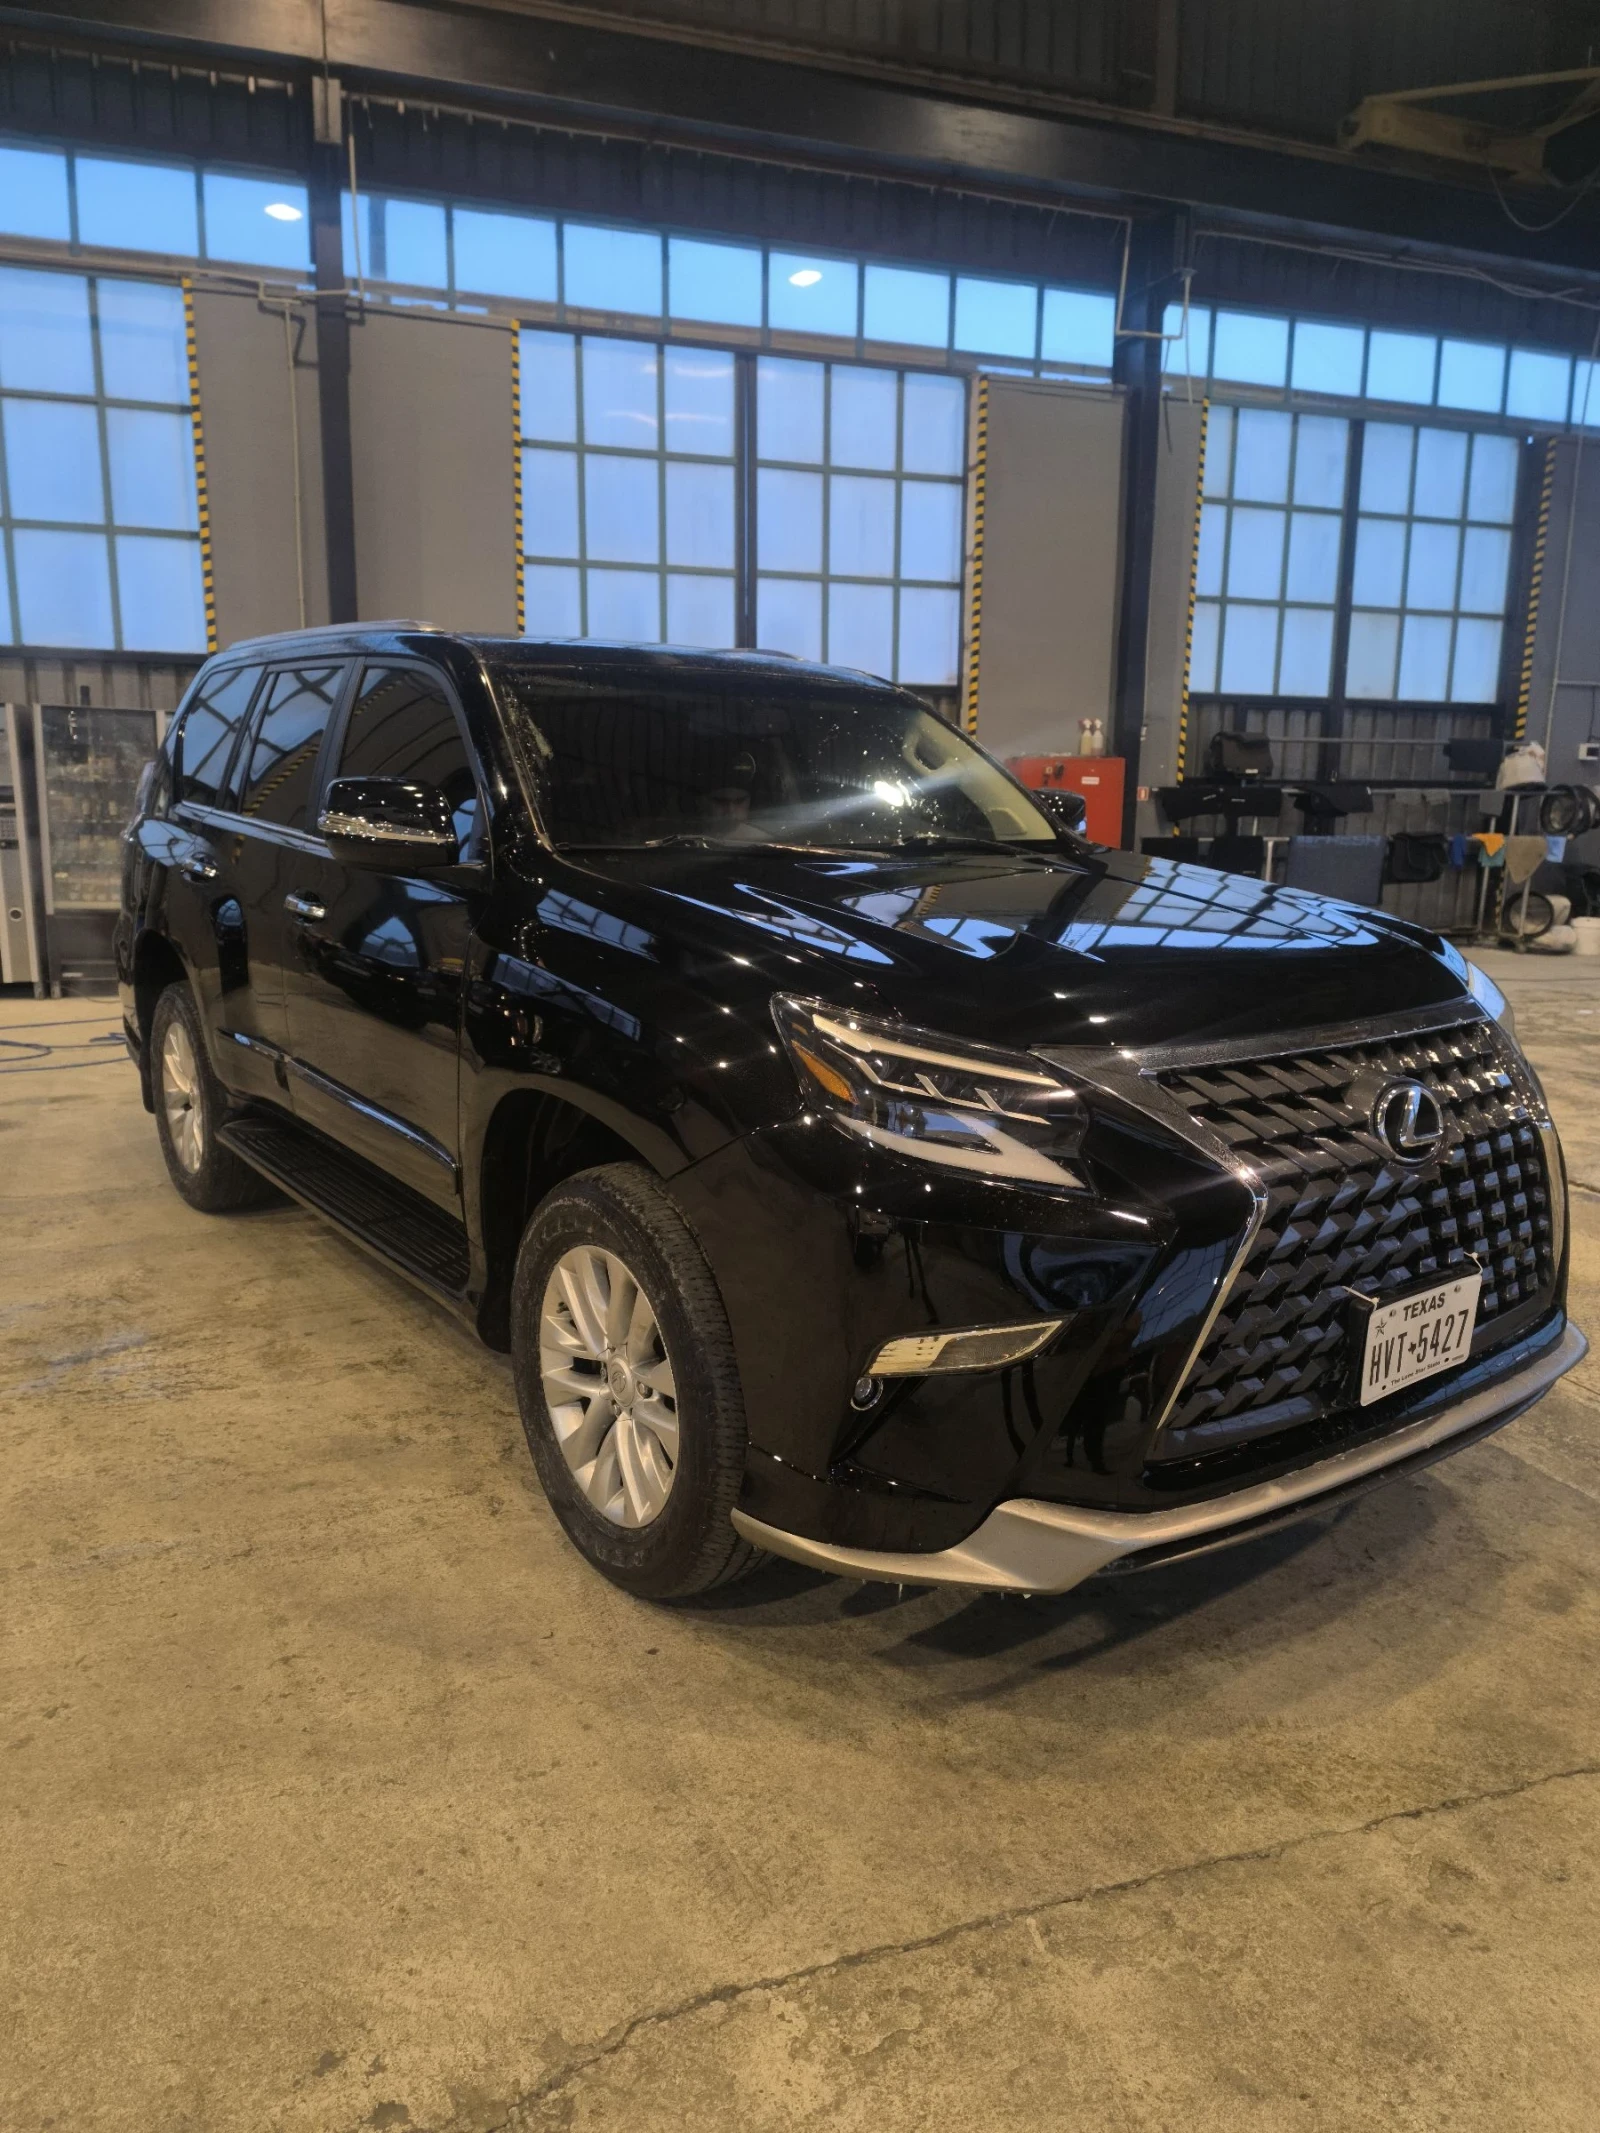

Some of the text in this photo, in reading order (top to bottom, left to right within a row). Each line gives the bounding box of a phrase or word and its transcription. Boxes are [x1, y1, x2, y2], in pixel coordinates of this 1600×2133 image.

[1403, 1292, 1446, 1321] TEXAS
[1369, 1308, 1469, 1386] HVT 5427
